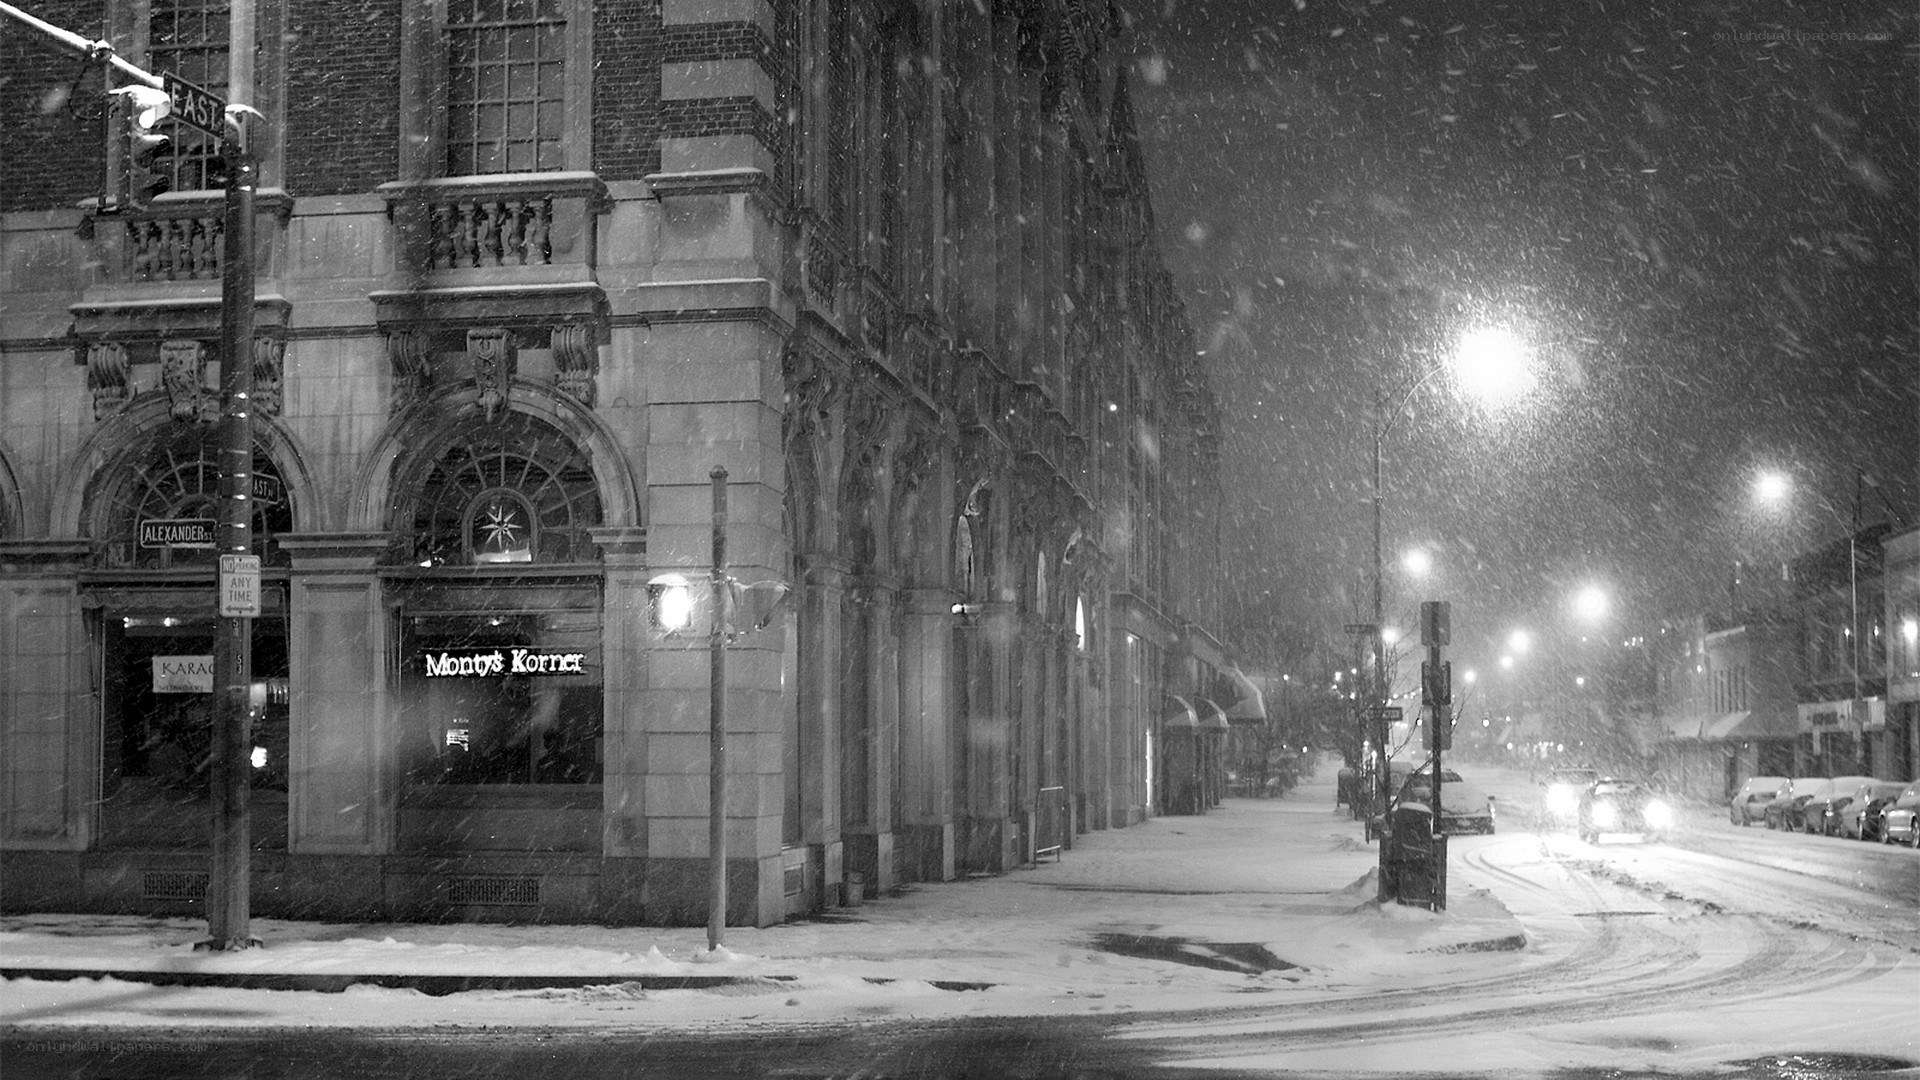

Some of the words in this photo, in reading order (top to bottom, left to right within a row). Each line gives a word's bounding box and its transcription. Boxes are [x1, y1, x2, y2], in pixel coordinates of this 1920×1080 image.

[172, 82, 218, 130] EAST
[252, 479, 267, 496] AST
[144, 525, 204, 542] ALEXANDER
[223, 559, 233, 572] NO
[230, 577, 252, 588] ANY
[229, 590, 252, 602] TIME
[511, 649, 584, 673] Korner
